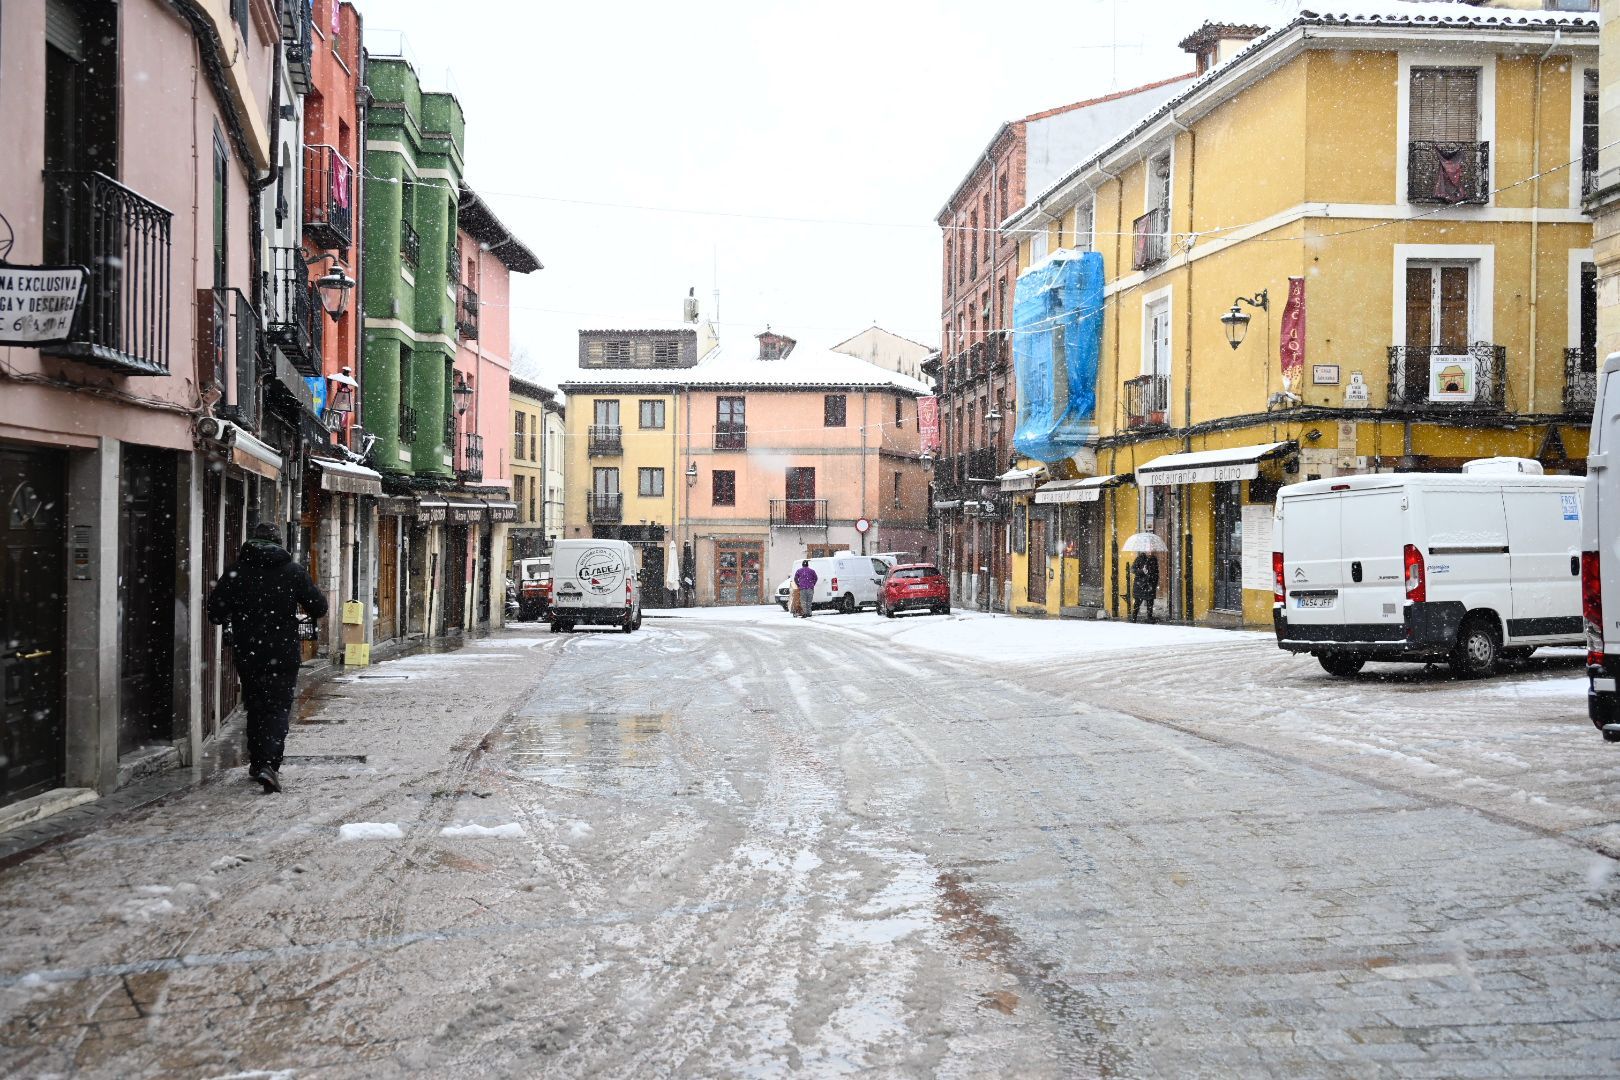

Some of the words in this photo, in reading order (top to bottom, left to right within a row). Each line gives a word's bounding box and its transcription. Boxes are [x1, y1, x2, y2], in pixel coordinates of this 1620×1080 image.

[18, 276, 77, 292] EXCLUSIVA
[17, 297, 24, 311] Y
[29, 296, 75, 313] DESCARGA
[1353, 376, 1360, 384] 6
[1151, 471, 1197, 485] restaurante
